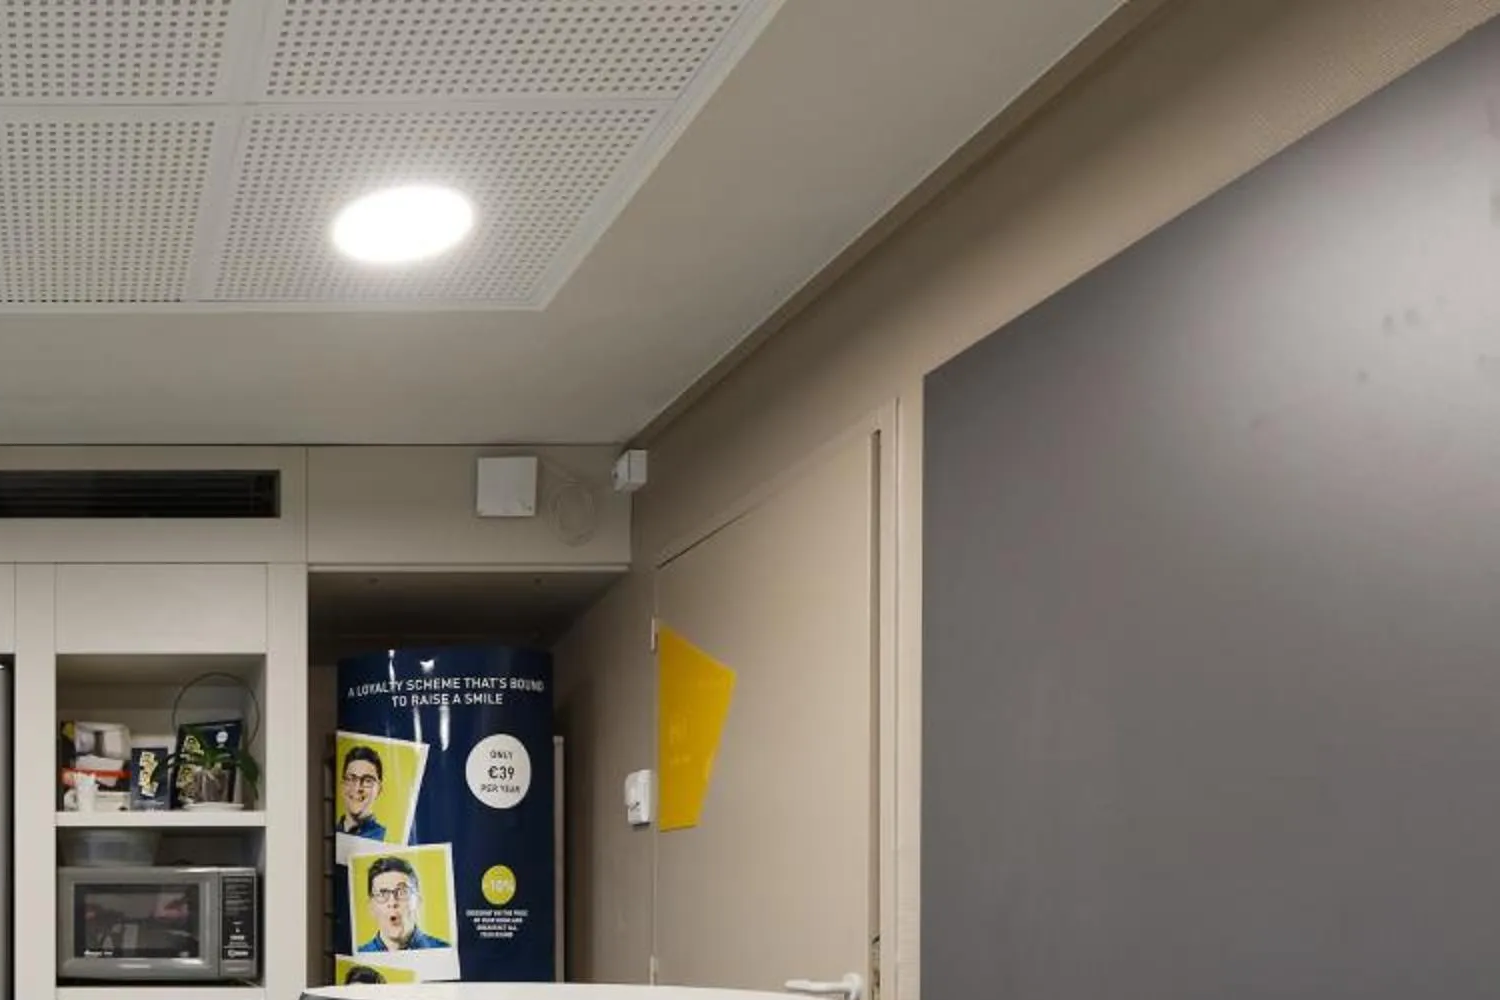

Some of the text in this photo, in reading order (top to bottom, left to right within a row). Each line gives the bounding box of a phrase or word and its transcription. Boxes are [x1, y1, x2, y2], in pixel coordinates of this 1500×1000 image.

[357, 680, 402, 698] LOYALTY
[406, 678, 460, 691] SCHEME
[463, 677, 508, 690] THAT'S
[510, 677, 545, 693] BOUND
[391, 693, 504, 708] TO RAISE A SMILE
[487, 766, 515, 780] €39
